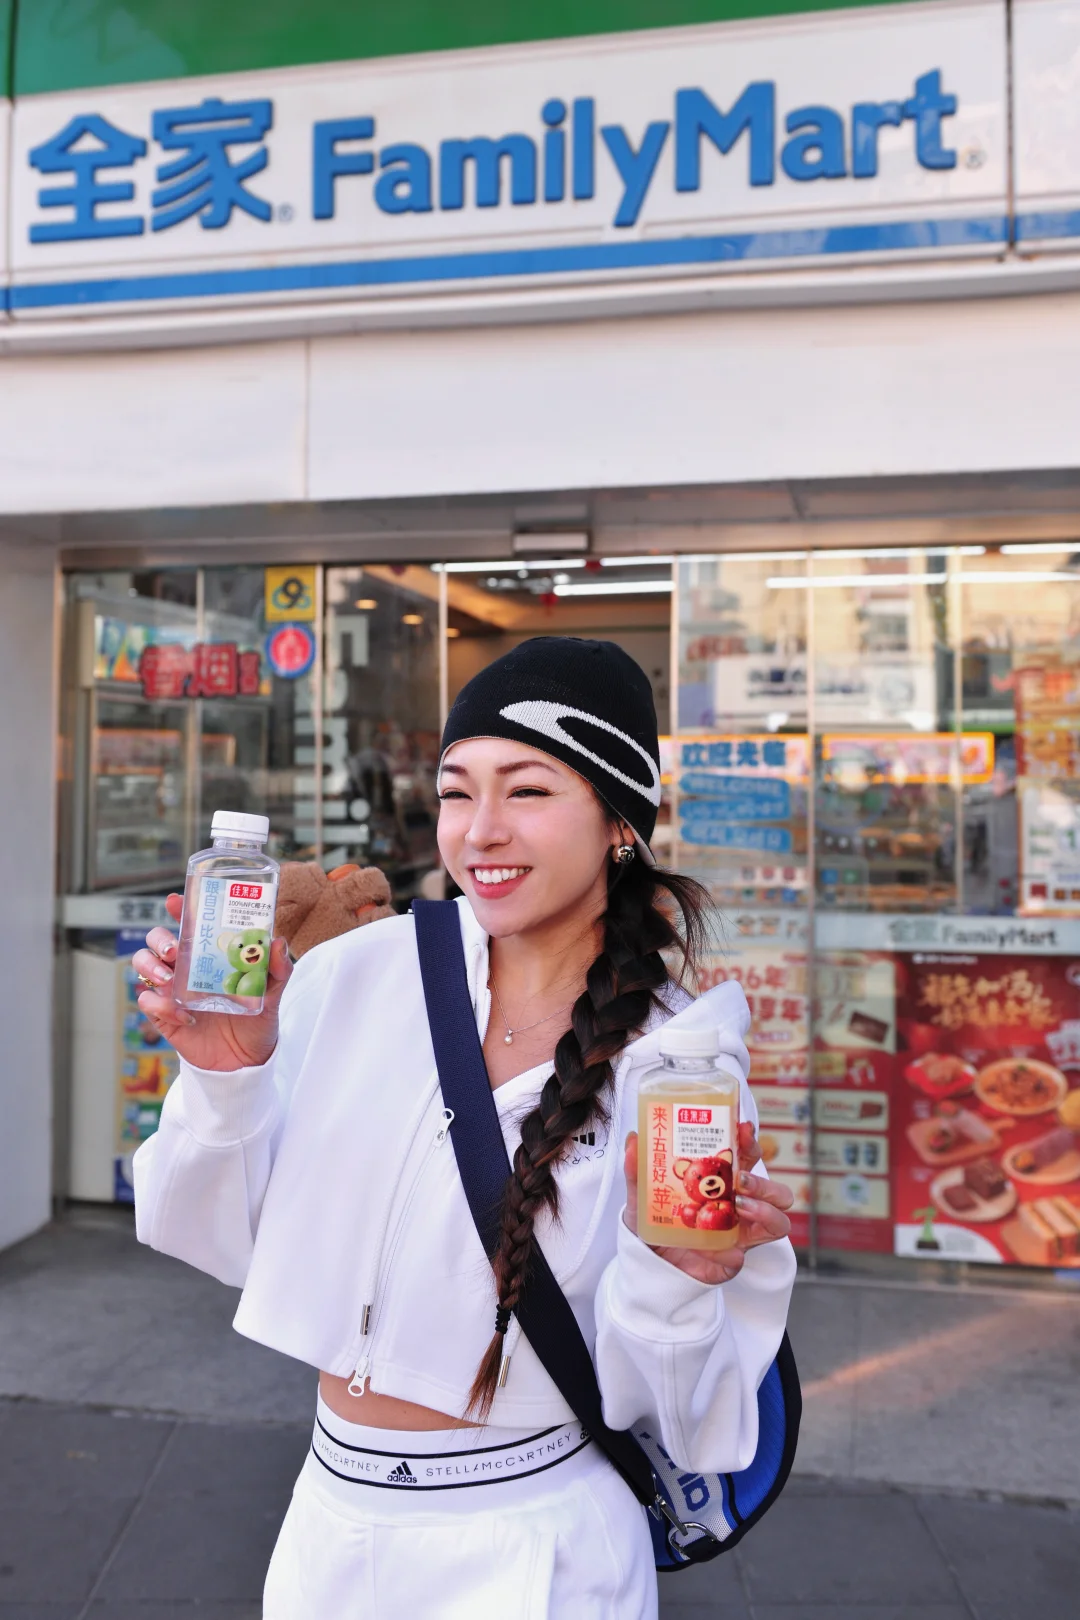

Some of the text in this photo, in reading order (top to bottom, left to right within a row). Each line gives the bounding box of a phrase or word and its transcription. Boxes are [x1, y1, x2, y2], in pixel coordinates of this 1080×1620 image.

[28, 98, 273, 244] 全家
[313, 68, 958, 228] FamilyMart
[294, 613, 369, 872] Famil
[942, 924, 1058, 947] FamilyMart
[386, 1474, 418, 1484] adidas
